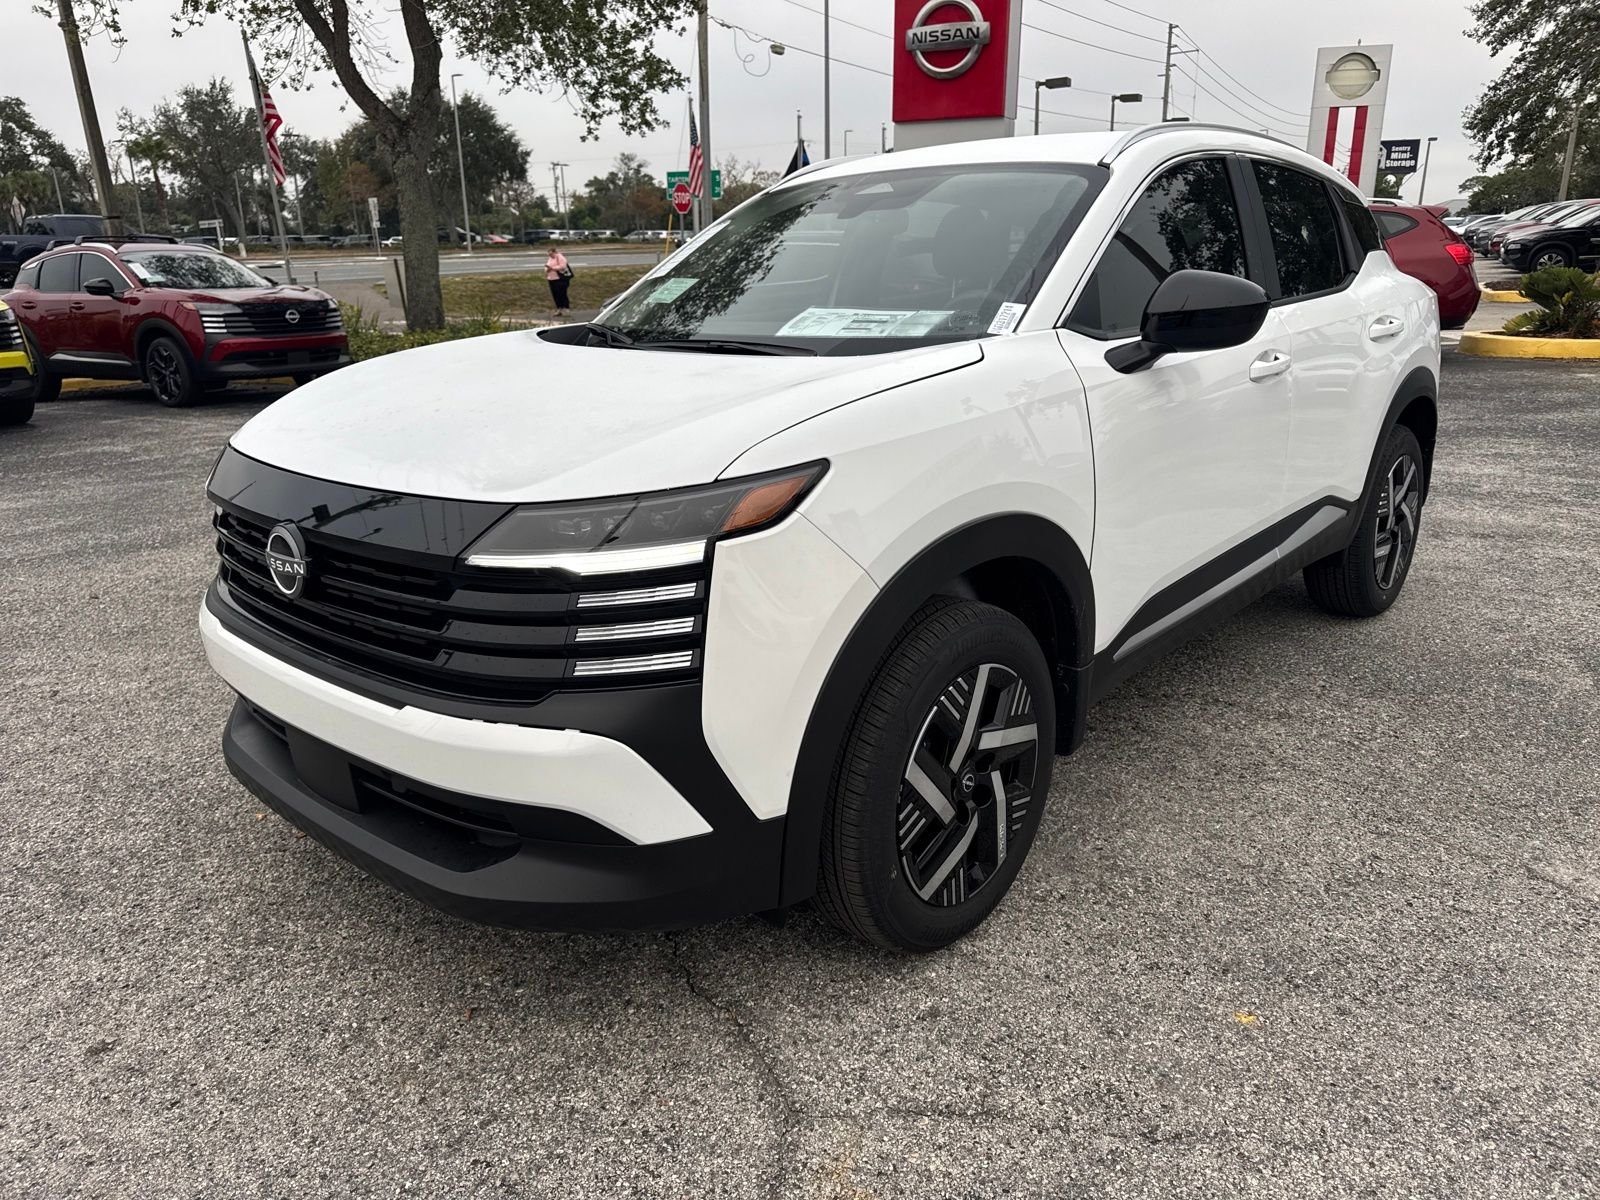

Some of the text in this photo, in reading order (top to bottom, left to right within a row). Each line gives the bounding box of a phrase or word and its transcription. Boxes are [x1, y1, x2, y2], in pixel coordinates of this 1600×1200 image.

[911, 26, 980, 45] NISSAN
[1390, 152, 1413, 160] Mini-
[1385, 159, 1415, 168] Storage
[673, 192, 690, 204] STOP
